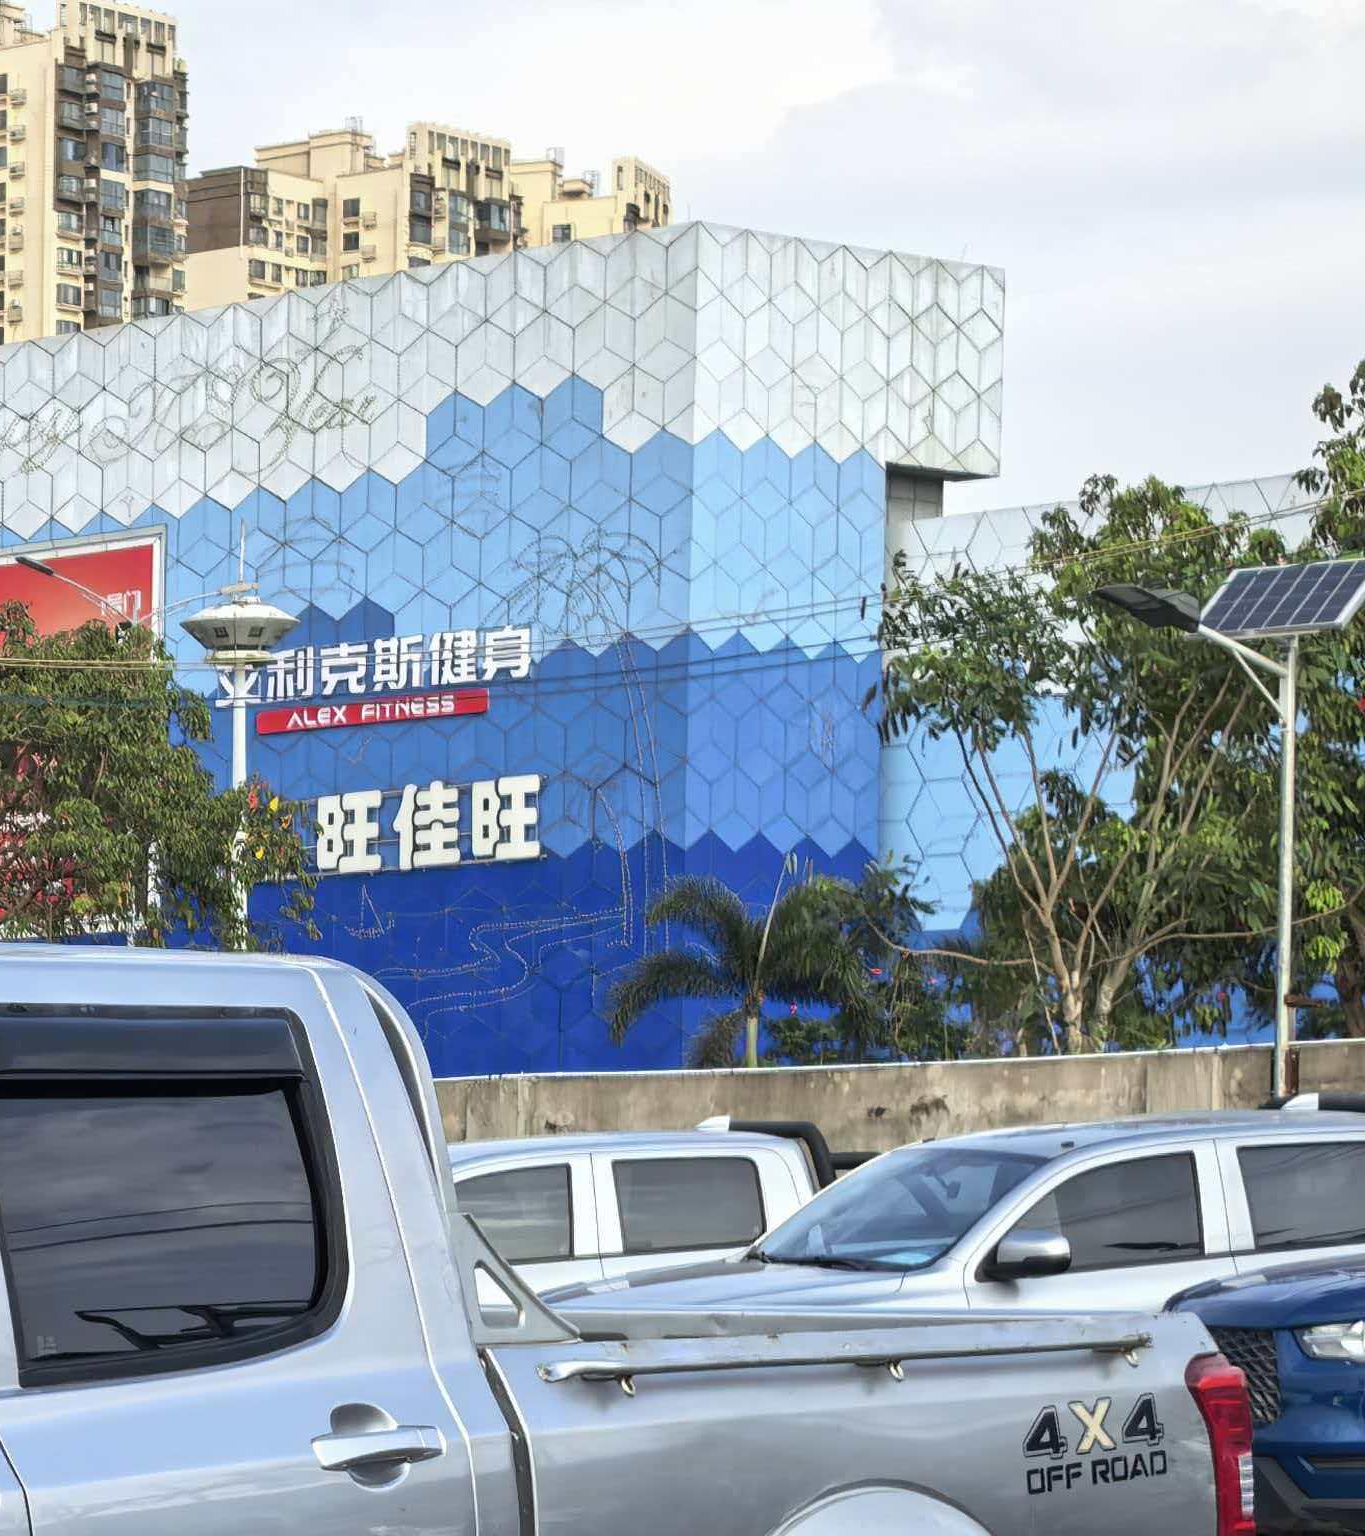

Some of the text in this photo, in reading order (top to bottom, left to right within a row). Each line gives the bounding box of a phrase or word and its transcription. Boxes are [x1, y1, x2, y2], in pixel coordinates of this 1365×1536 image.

[285, 695, 456, 730] ALEX FITNESS
[316, 773, 541, 874] 旺佳旺
[1026, 1449, 1168, 1495] OFF ROAD
